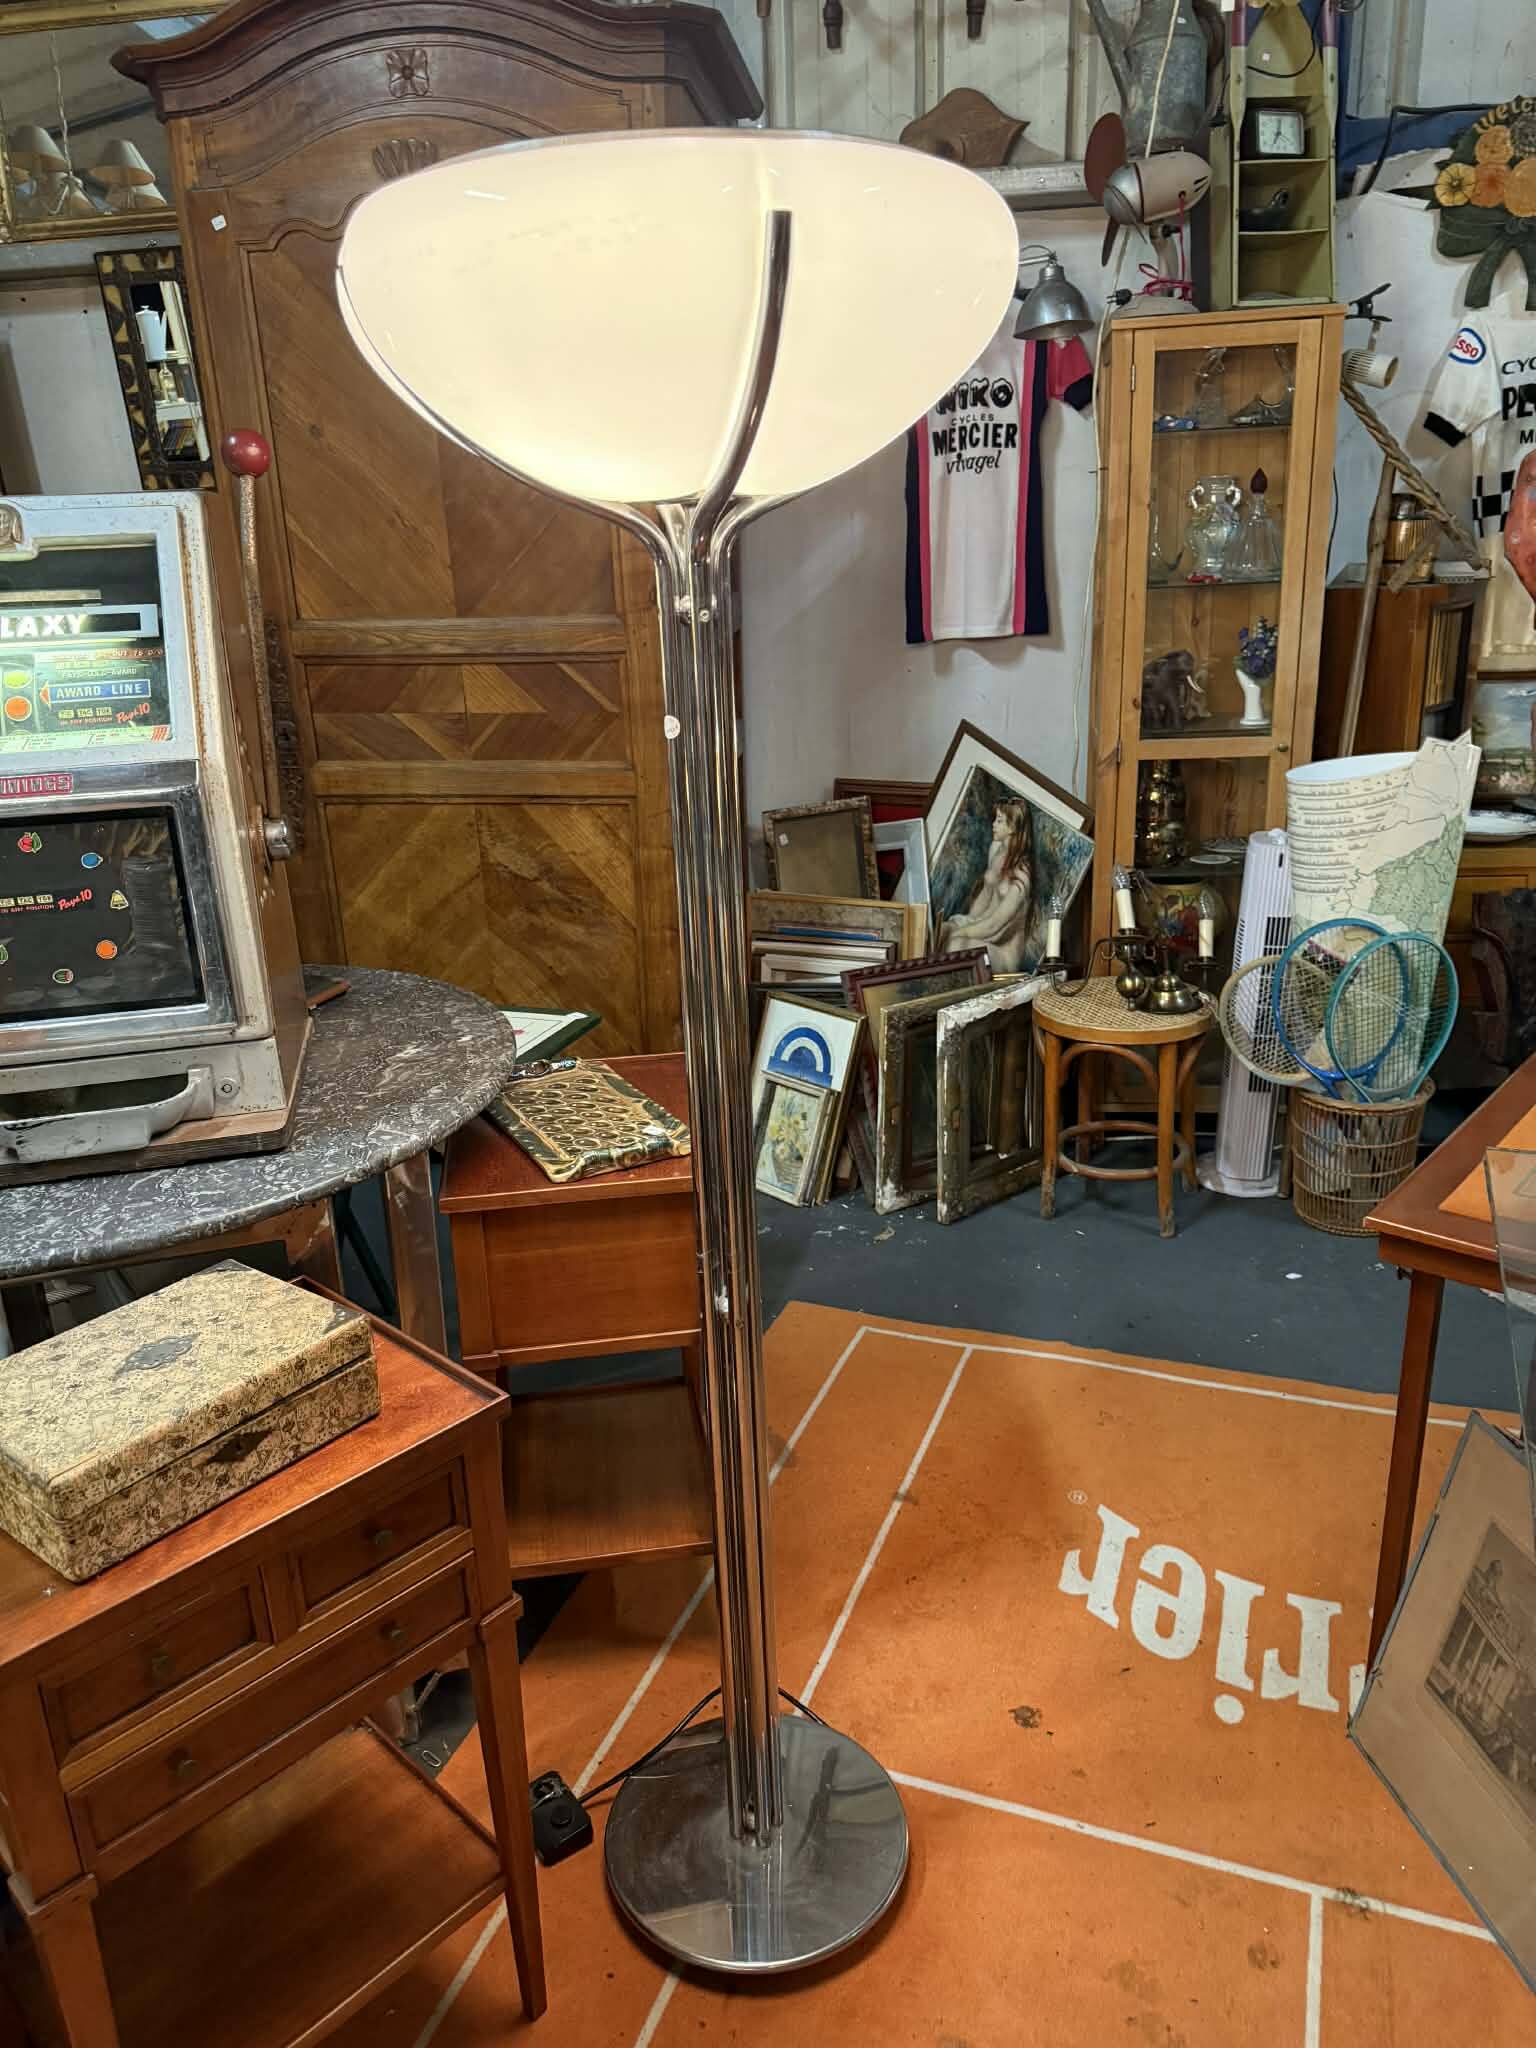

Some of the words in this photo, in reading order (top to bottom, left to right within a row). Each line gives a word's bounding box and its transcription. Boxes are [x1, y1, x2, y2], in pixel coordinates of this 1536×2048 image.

[1455, 335, 1479, 358] SSO
[1502, 384, 1536, 421] PE
[951, 413, 994, 426] CYCLES
[932, 422, 1018, 456] MERCIER
[0, 613, 87, 639] LAXY
[56, 685, 101, 699] AWARD
[111, 683, 143, 695] LINE
[138, 702, 150, 716] 10
[80, 888, 93, 902] 10
[1058, 1504, 1366, 1724] rier
